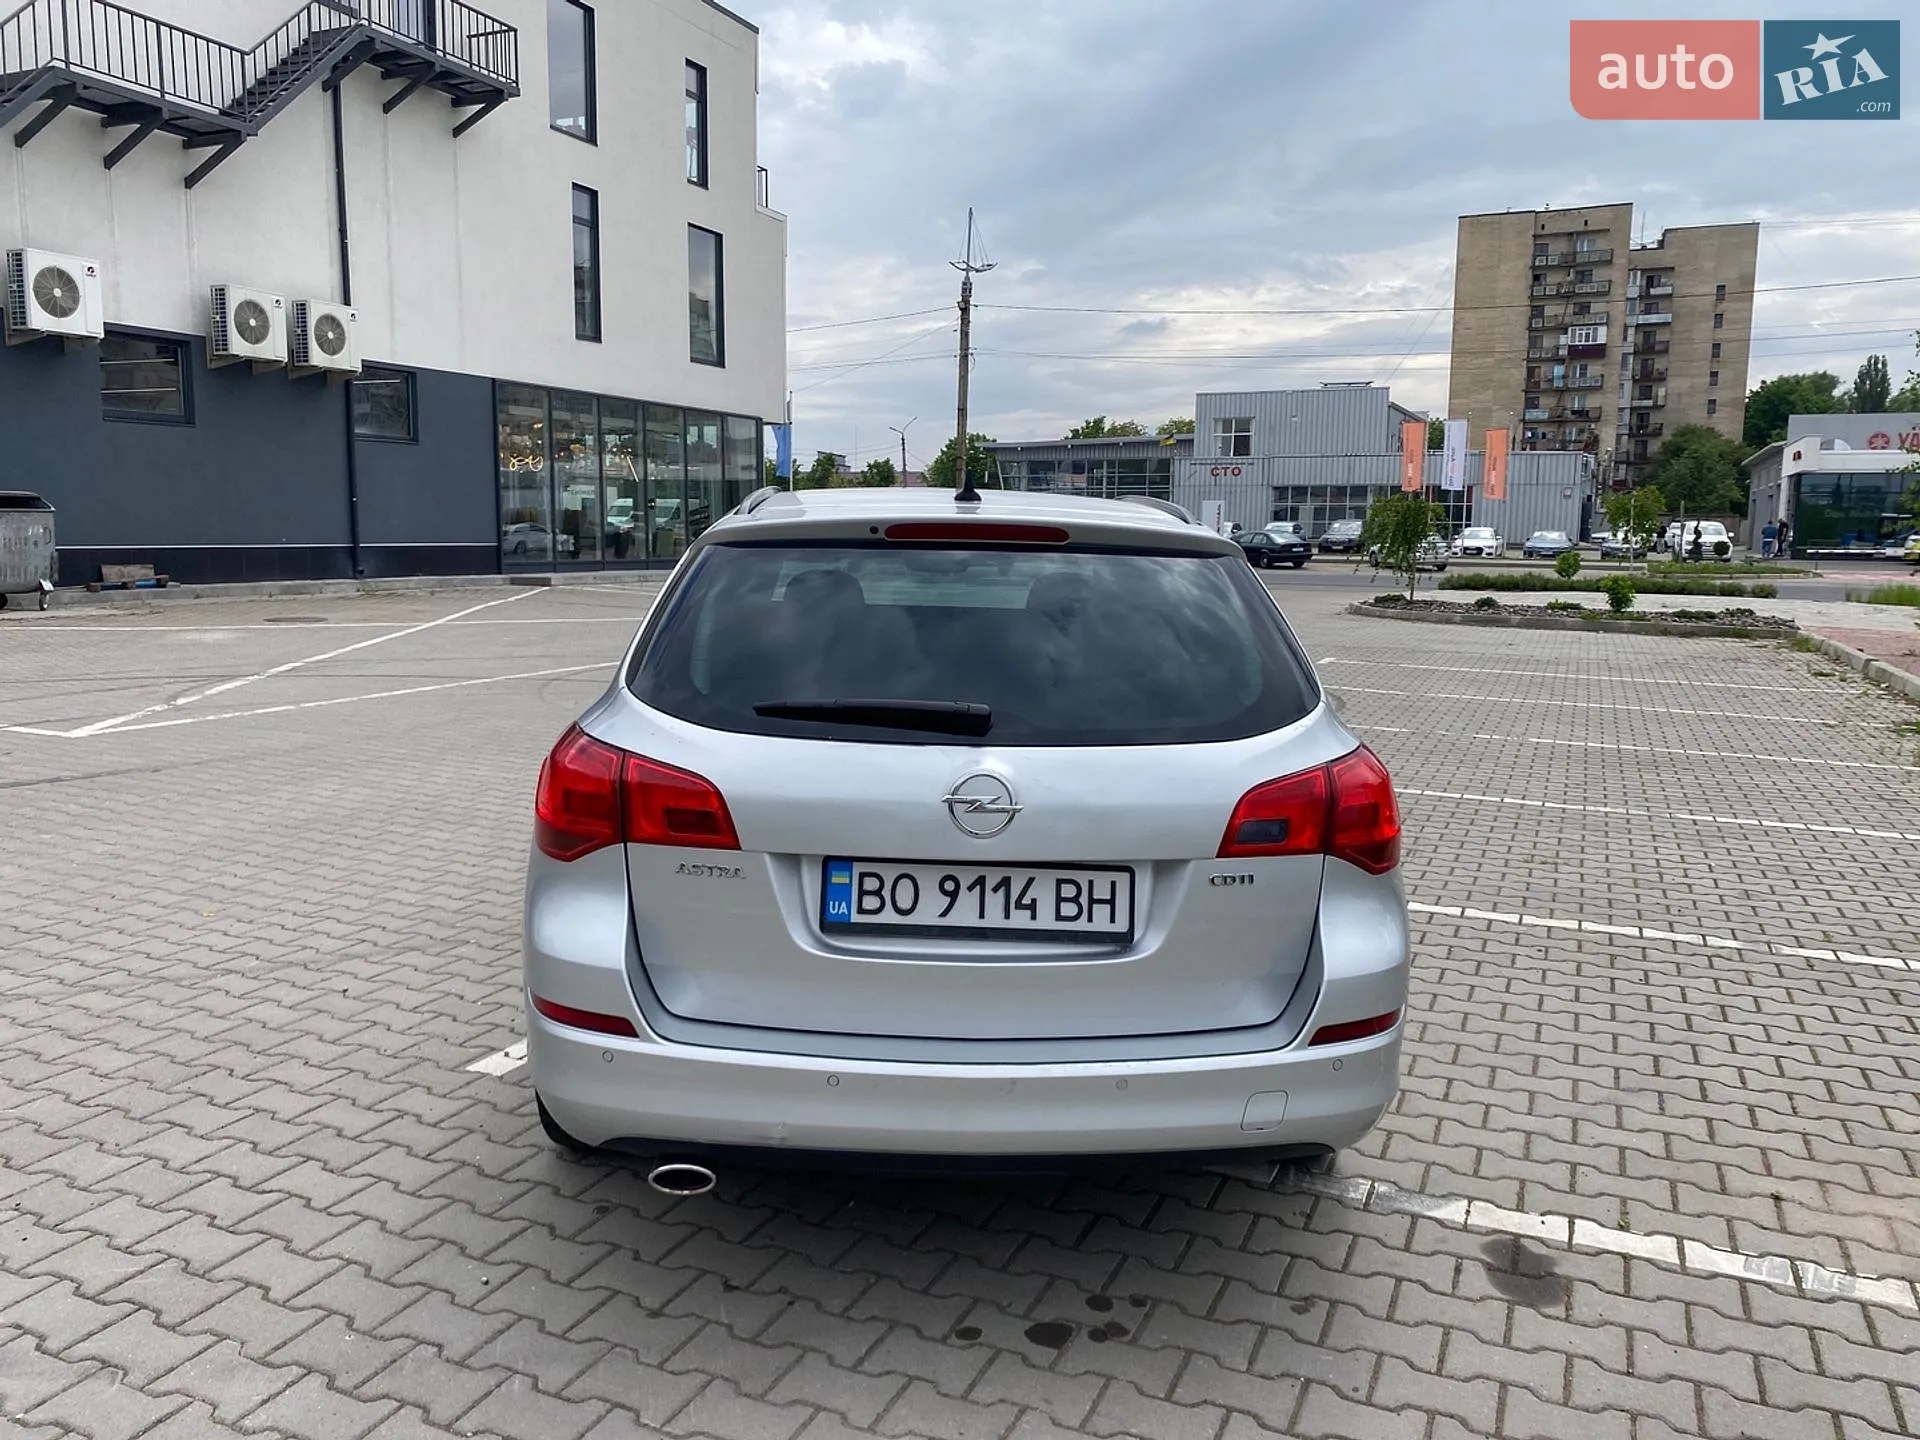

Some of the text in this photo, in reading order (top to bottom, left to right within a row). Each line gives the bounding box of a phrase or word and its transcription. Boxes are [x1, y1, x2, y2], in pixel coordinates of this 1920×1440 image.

[1210, 466, 1242, 477] СТО
[675, 861, 746, 880] ASTRA
[856, 871, 1117, 924] BO 9114 BH
[829, 900, 848, 915] UA
